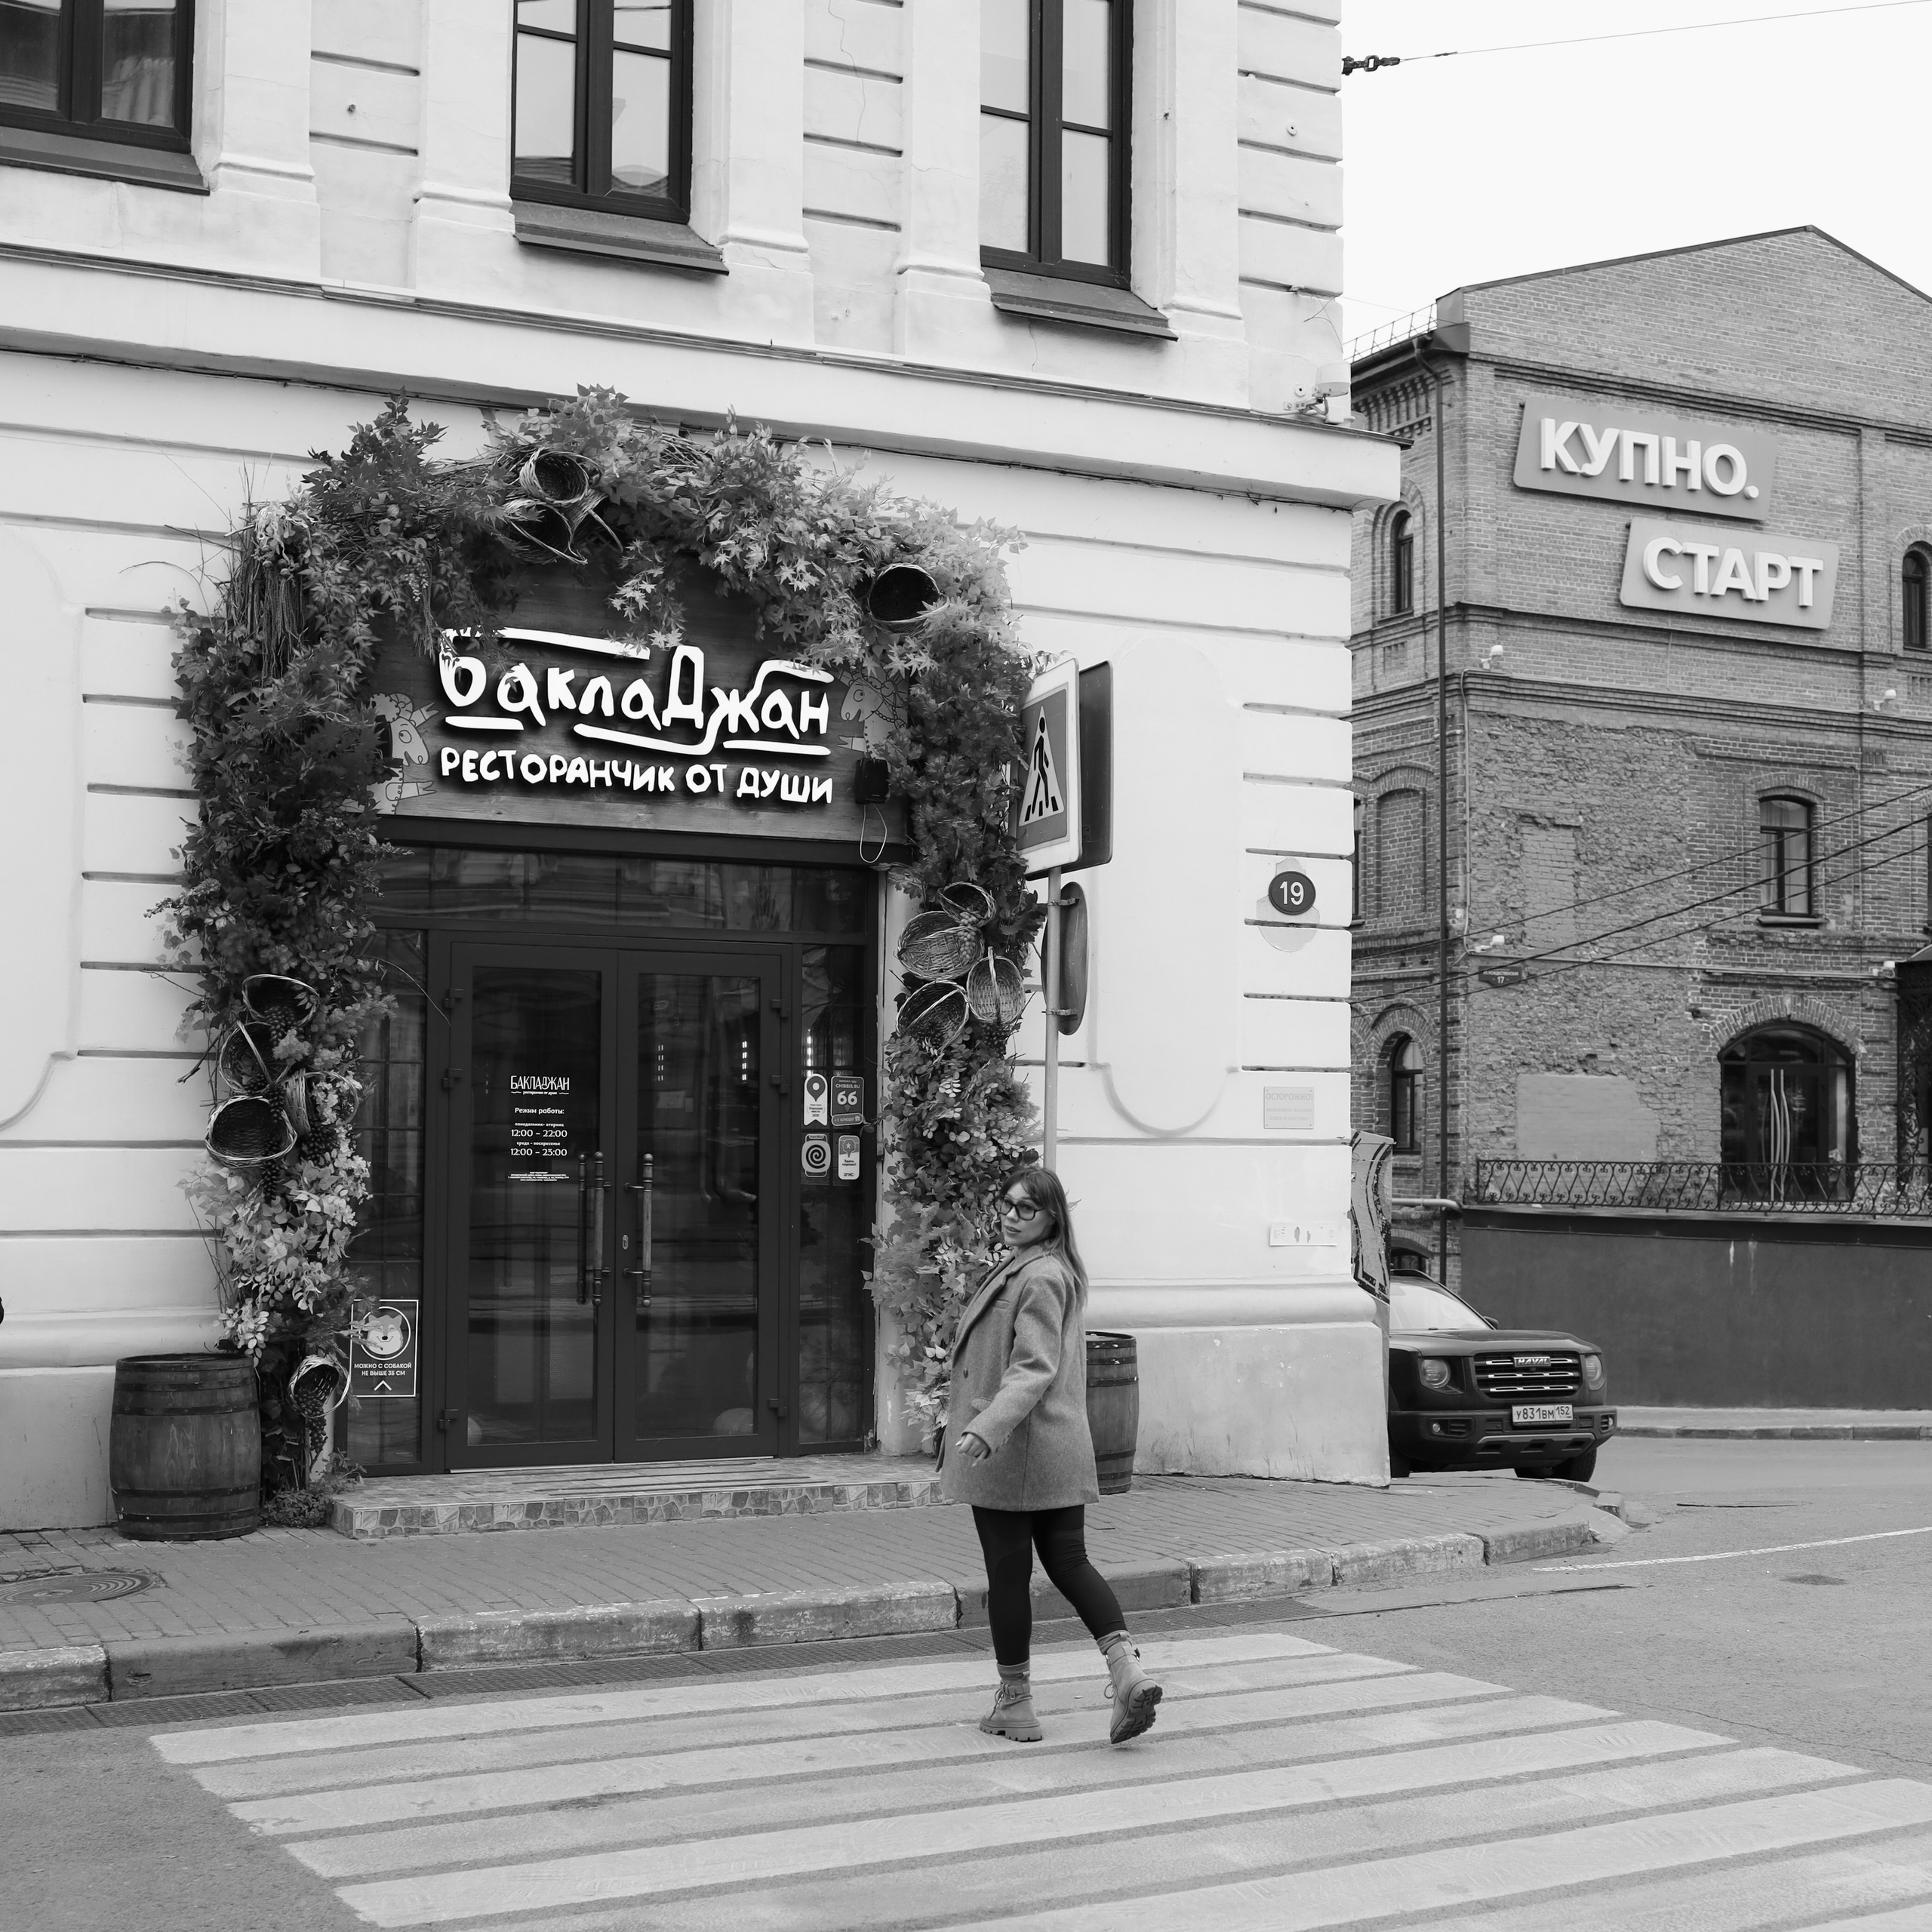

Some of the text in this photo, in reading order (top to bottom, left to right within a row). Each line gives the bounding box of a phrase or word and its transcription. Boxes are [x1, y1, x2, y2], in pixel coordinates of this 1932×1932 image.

[1540, 417, 1760, 500] КУПНО.
[1642, 537, 1824, 607] СТАРТ
[441, 746, 833, 804] РЕСТОРАНЧИК ОТ ДУШИ
[1279, 881, 1305, 906] 19
[1497, 976, 1505, 984] 17
[510, 1075, 570, 1091] БАКЛАДЖАН
[510, 1129, 534, 1137] 12:00
[543, 1129, 568, 1137] 22:00
[510, 1148, 533, 1156] 12:00
[542, 1148, 568, 1156] 23:00
[1555, 1406, 1570, 1416] 152
